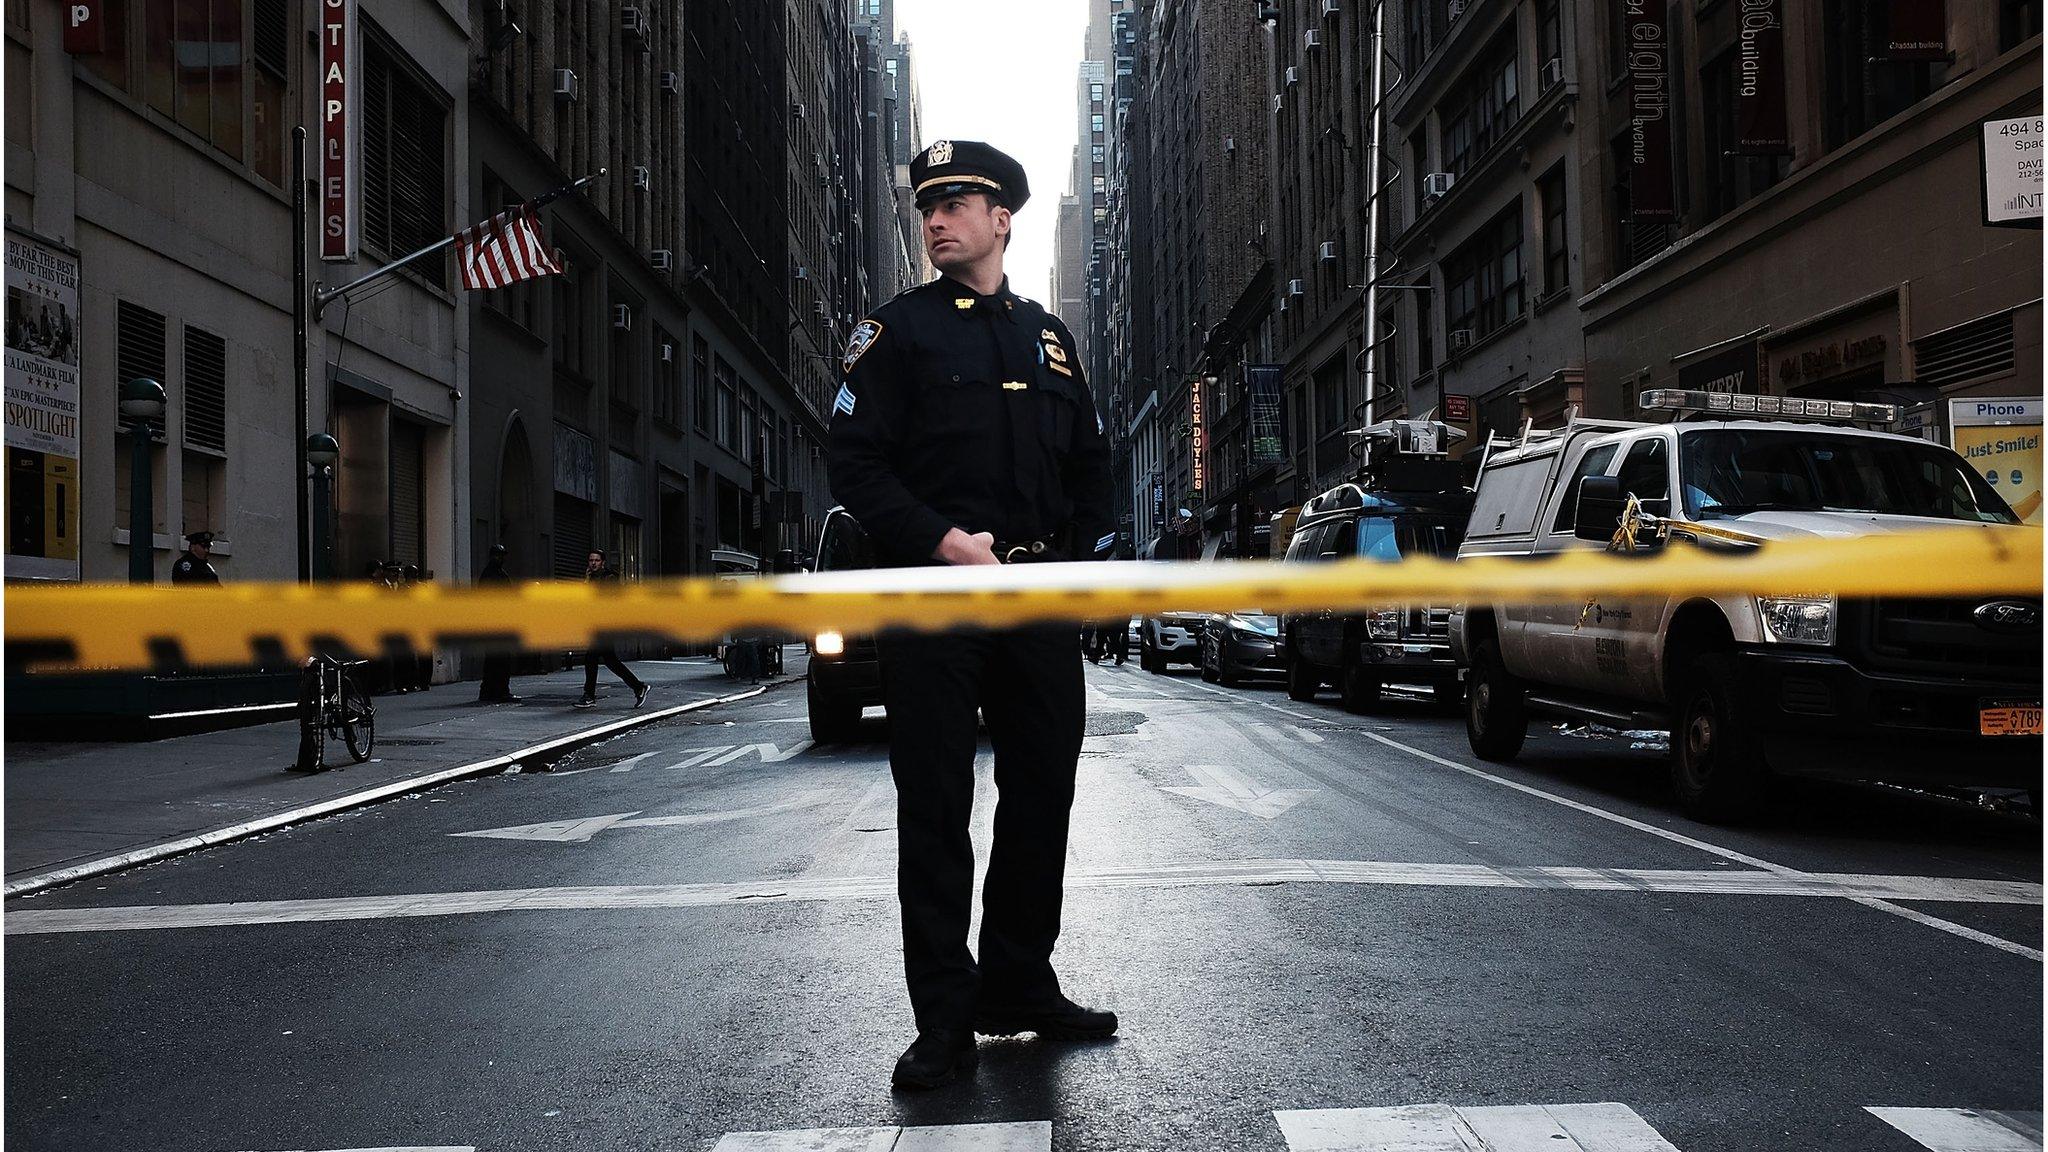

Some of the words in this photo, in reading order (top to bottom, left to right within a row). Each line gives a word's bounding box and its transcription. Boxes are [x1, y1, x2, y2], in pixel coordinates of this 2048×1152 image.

[71, 4, 90, 27] p
[1918, 40, 1944, 50] building
[1627, 22, 1669, 121] eighth
[1741, 28, 1759, 97] building
[1632, 115, 1646, 165] avenue
[2000, 122, 2028, 136] 494
[10, 241, 21, 256] BY
[21, 245, 37, 262] FAR
[39, 252, 56, 269] THE
[57, 259, 75, 276] BEST
[10, 254, 36, 275] MOVIE
[37, 265, 55, 282] THIS
[17, 358, 58, 380] LANDMARK
[59, 370, 75, 384] FILM
[21, 390, 34, 402] EPIC
[1192, 382, 1200, 424] JACK
[10, 402, 77, 439] SPOTLIGHT
[1977, 403, 2024, 416] Phone
[1193, 426, 1202, 490] DOYLES
[1964, 442, 1992, 459] Just
[1995, 435, 2039, 454] Smile!
[1993, 605, 2036, 625] Ford
[2010, 710, 2018, 719] A
[2019, 710, 2042, 728] 789
